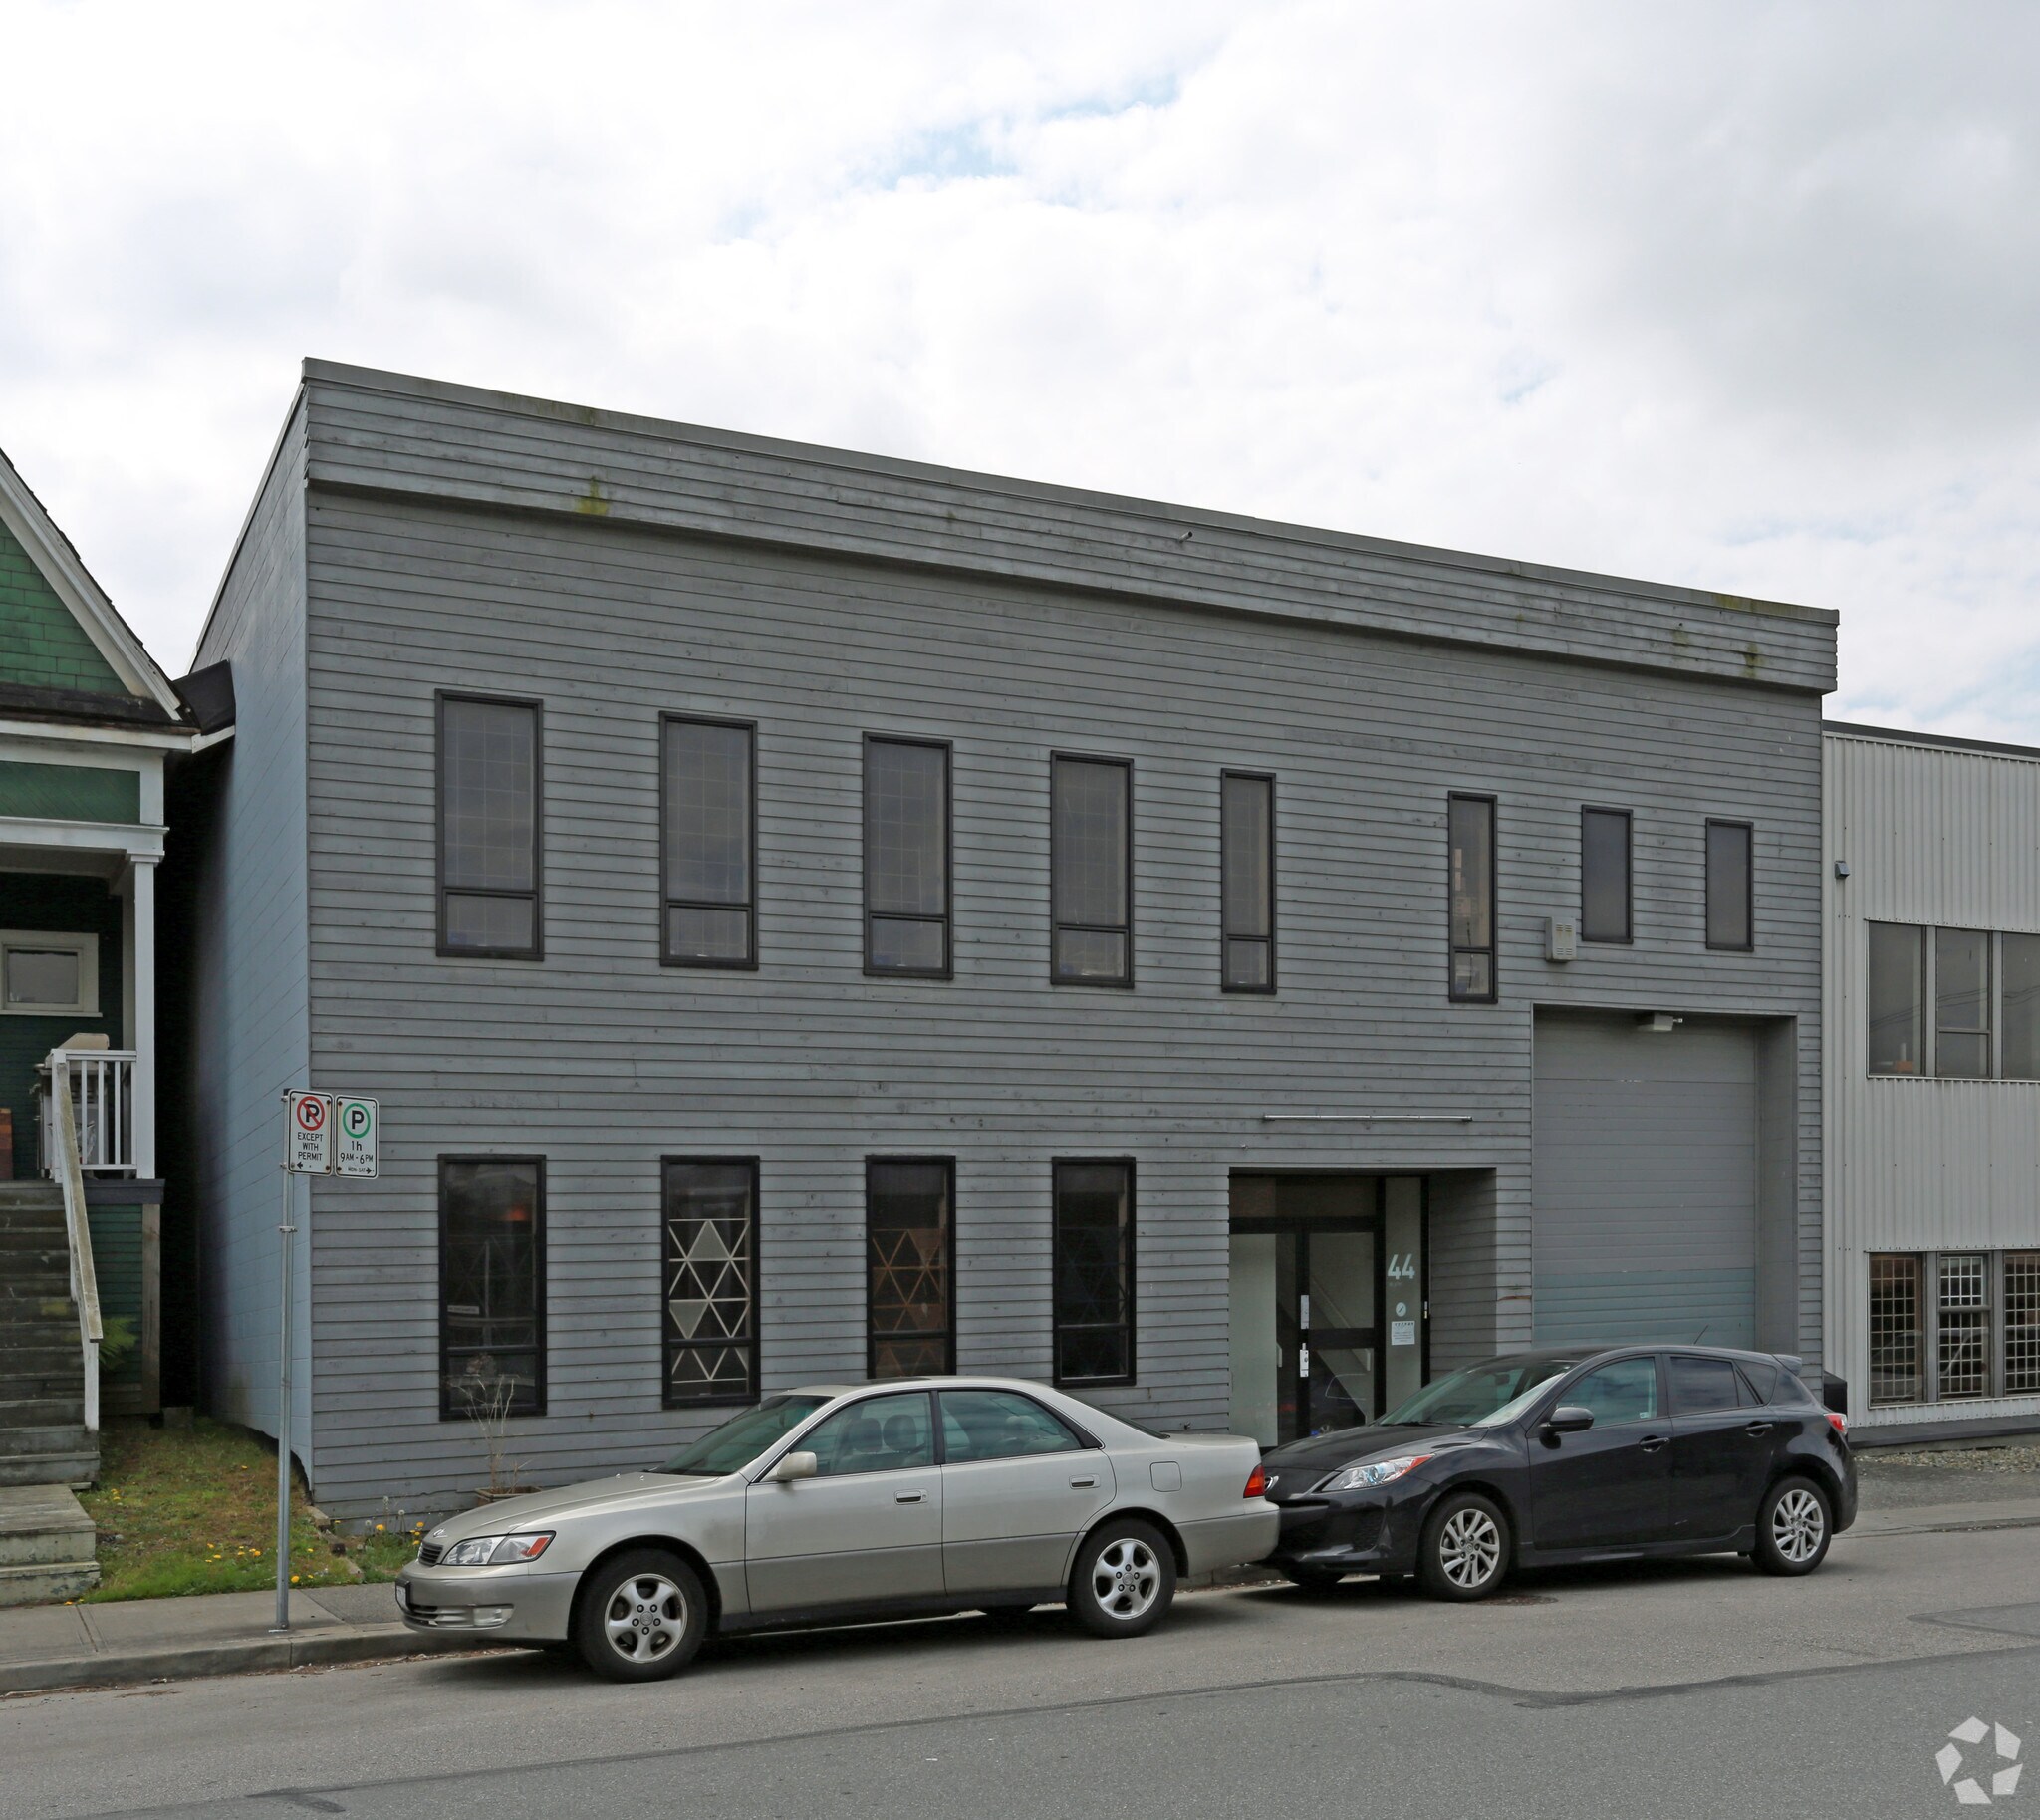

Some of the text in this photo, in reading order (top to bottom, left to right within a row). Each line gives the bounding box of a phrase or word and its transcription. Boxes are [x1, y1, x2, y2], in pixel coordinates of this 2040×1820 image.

[352, 1110, 365, 1130] P
[298, 1132, 324, 1142] EXCEPT
[298, 1152, 323, 1161] PERMIT
[1388, 1254, 1415, 1280] 44
